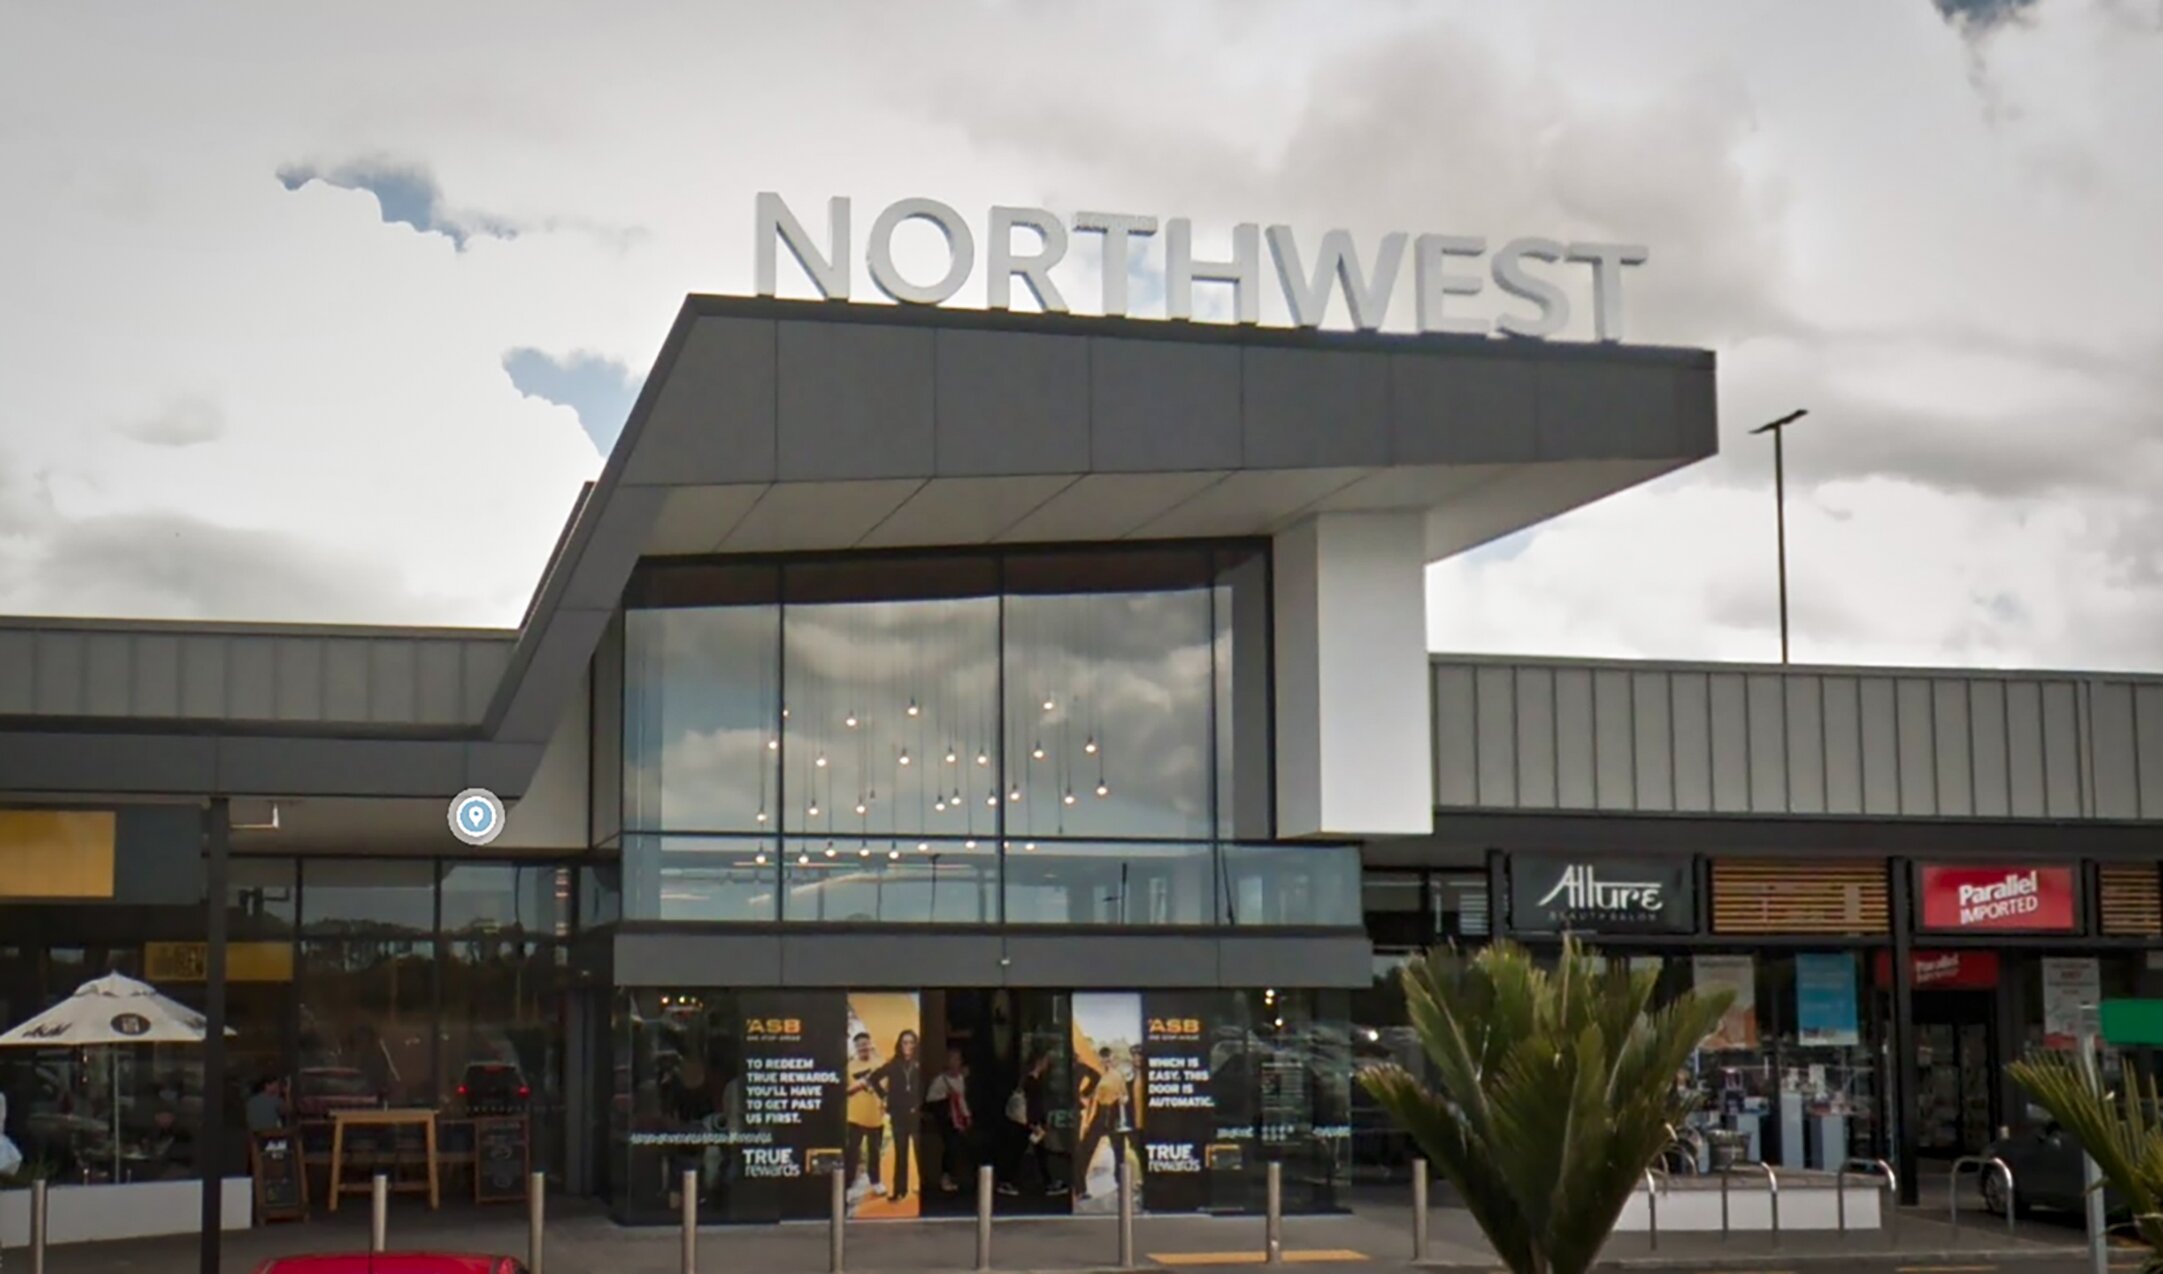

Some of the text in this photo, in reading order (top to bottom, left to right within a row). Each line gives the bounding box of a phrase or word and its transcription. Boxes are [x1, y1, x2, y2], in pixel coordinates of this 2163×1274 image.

[754, 191, 1649, 343] NORTHWEST
[1538, 864, 1663, 911] Allure
[1958, 870, 2038, 906] Parallel
[1960, 896, 2039, 924] IMPORTED
[746, 1058, 814, 1069] TO REDEEM
[1148, 1058, 1186, 1068] WHICH
[746, 1072, 778, 1083] TRUE
[1183, 1071, 1209, 1081] THIS
[790, 1086, 822, 1097] HAVE
[1148, 1084, 1180, 1094] DOOR
[746, 1099, 822, 1110] TO GET PAST
[746, 1113, 762, 1124] US
[743, 1149, 793, 1164] TRUE
[1146, 1145, 1193, 1160] TRUE
